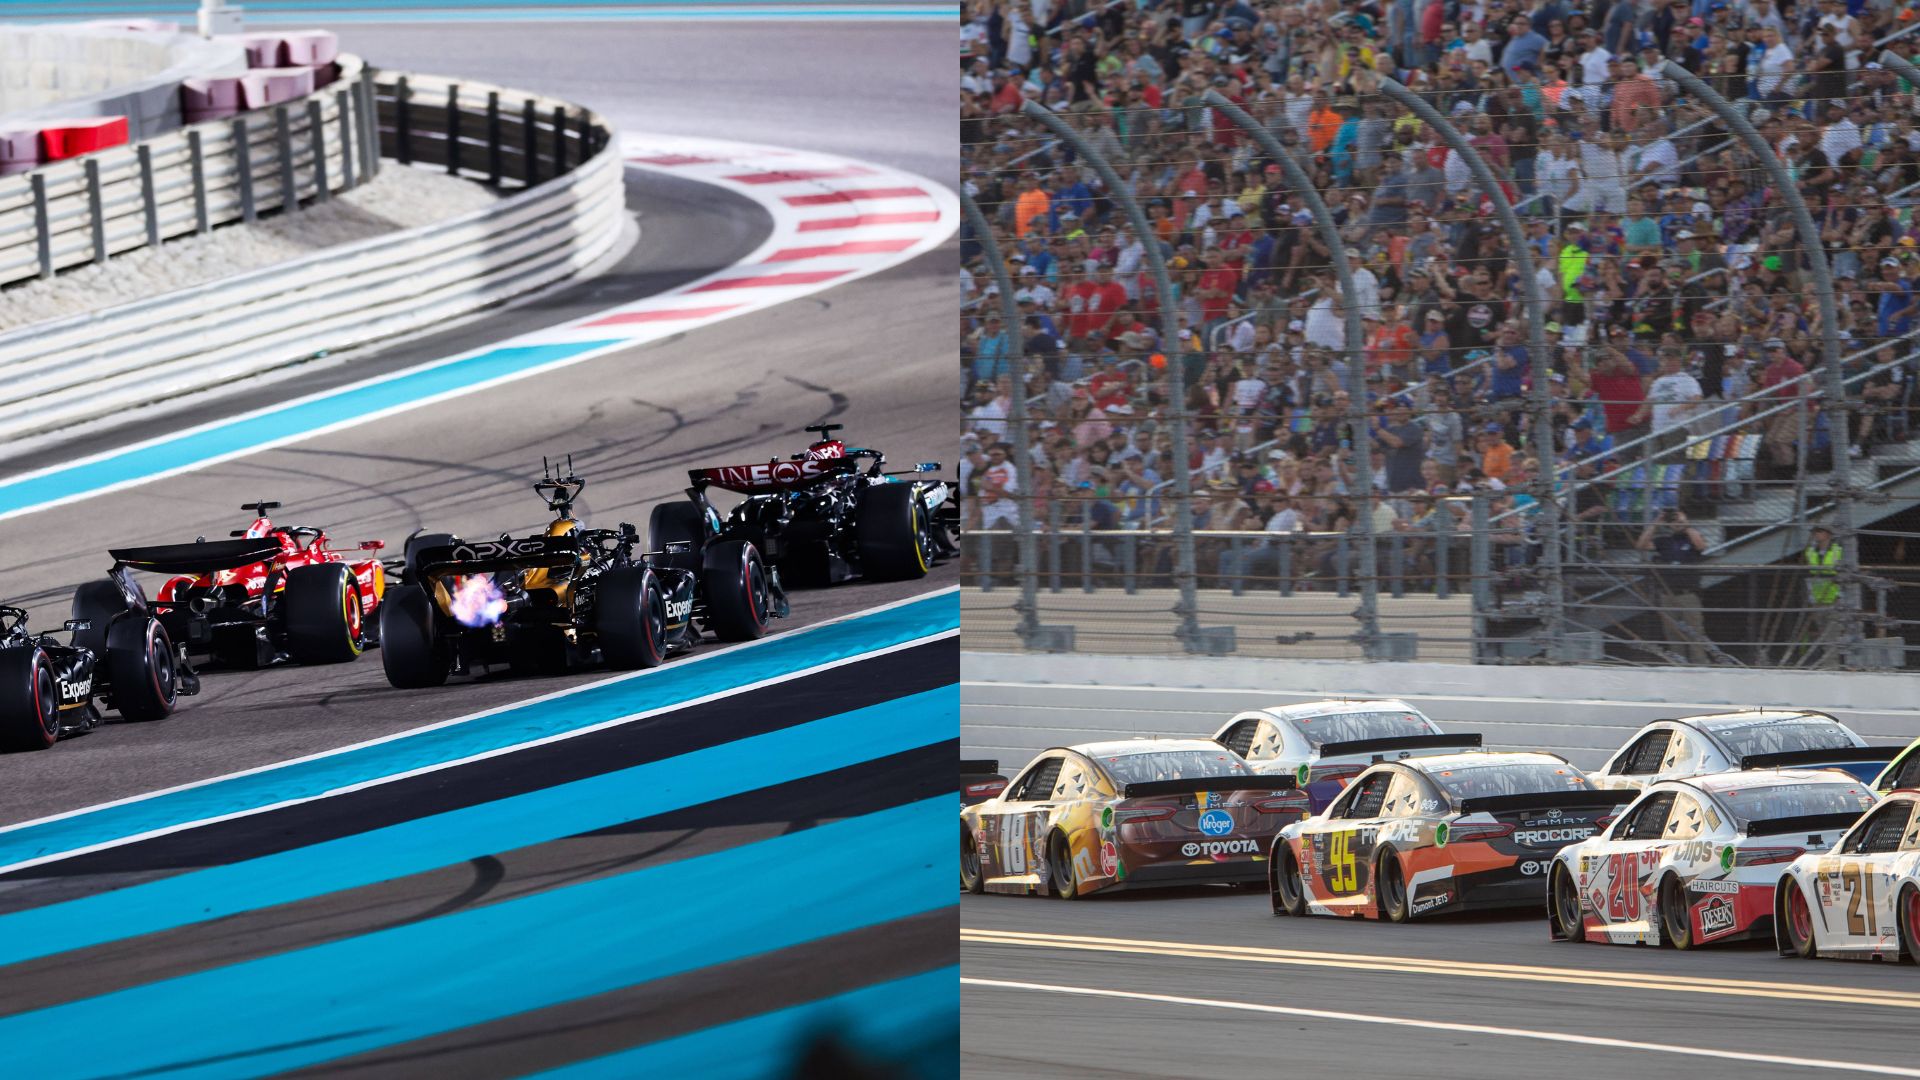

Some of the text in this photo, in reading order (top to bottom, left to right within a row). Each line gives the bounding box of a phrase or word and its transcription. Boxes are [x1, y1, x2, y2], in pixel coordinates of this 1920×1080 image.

[719, 460, 822, 484] INEOS
[1203, 814, 1231, 834] Kroger
[1525, 817, 1587, 827] CAMRY
[1514, 827, 1595, 844] PROCORE
[1201, 840, 1259, 855] TOYOTA
[1330, 829, 1357, 892] 95
[1608, 852, 1640, 922] 20
[1692, 882, 1738, 893] HAIRCUTS
[1842, 862, 1877, 936] 21
